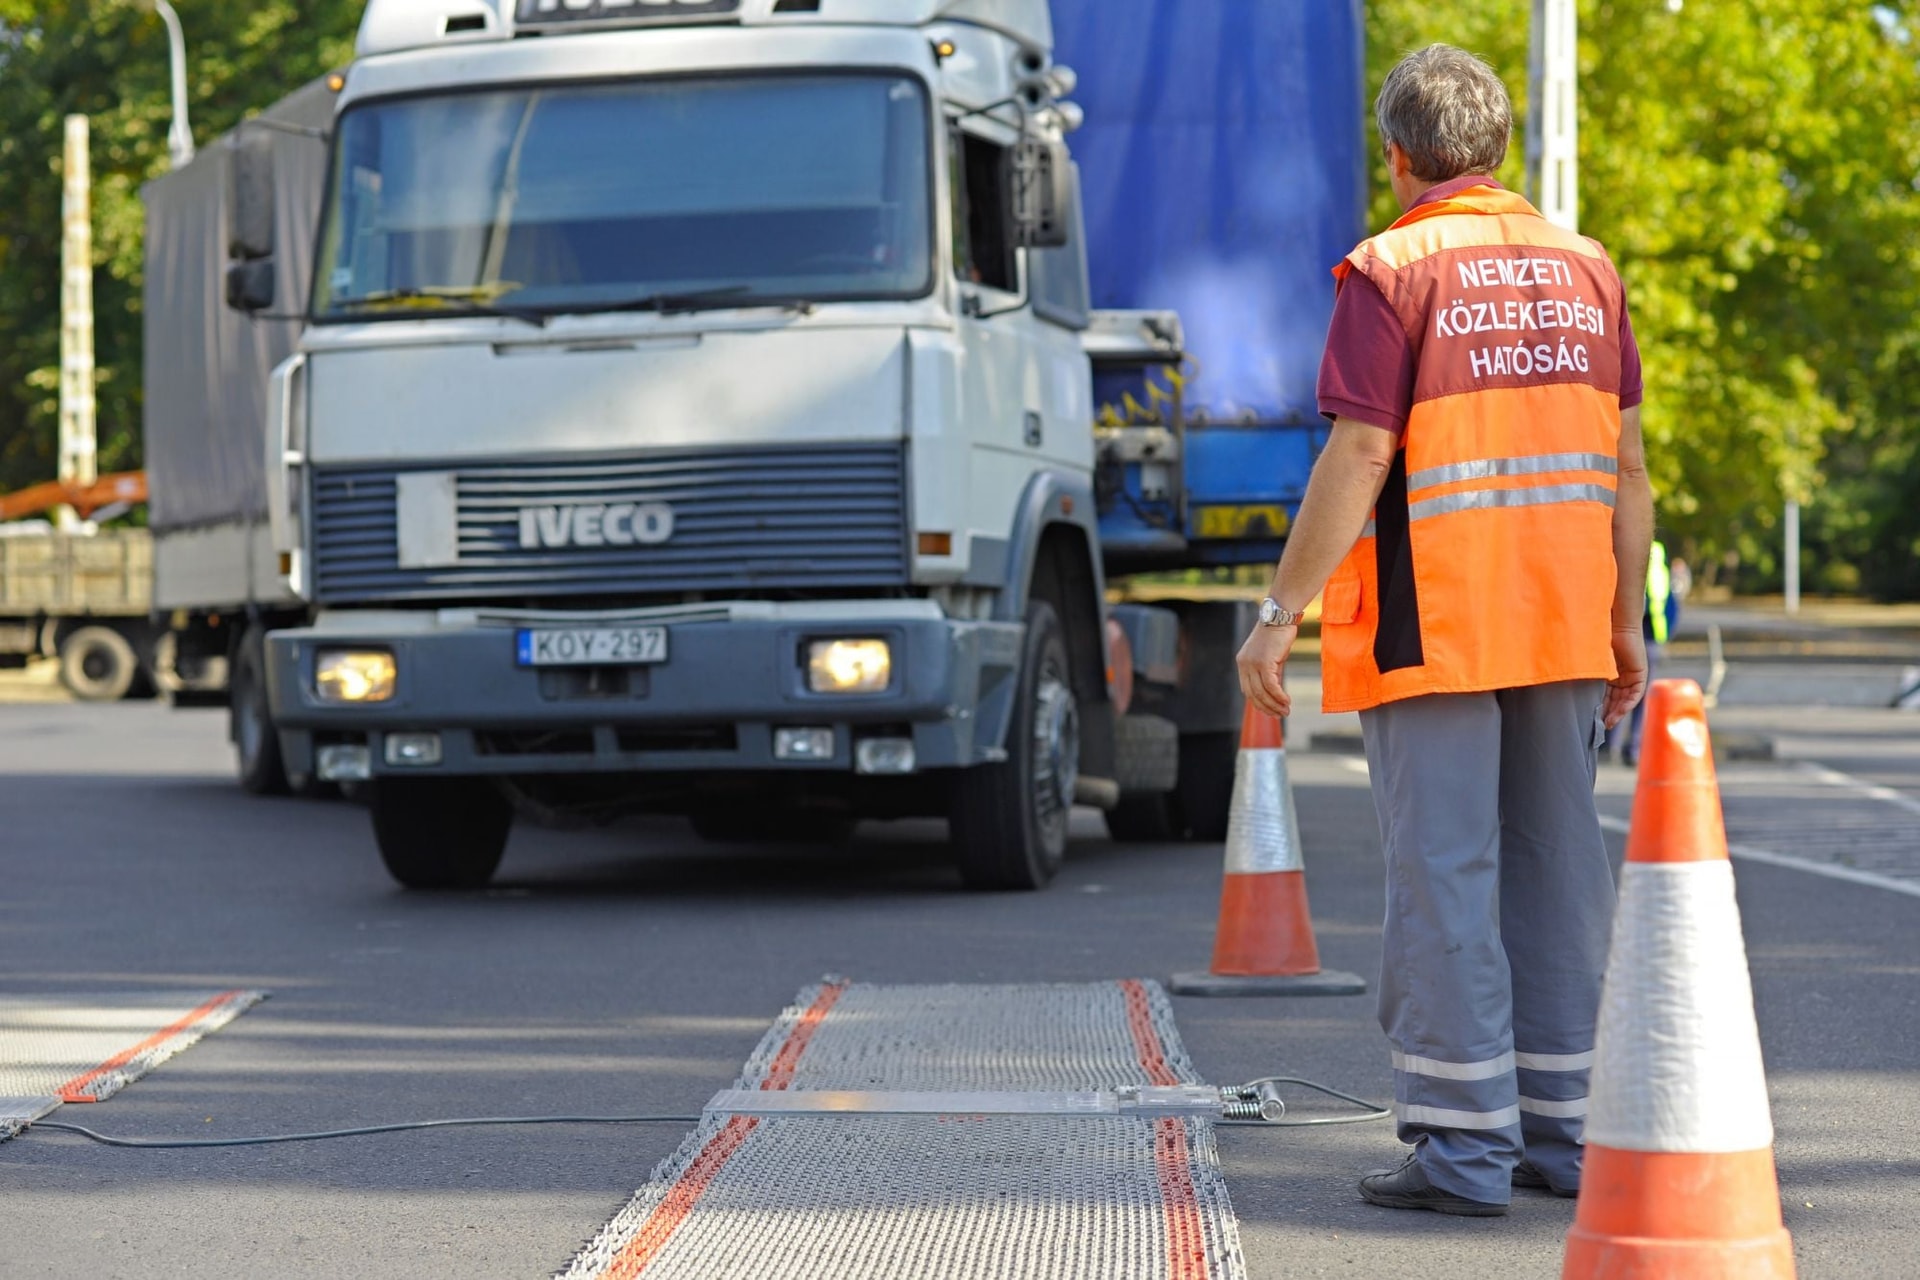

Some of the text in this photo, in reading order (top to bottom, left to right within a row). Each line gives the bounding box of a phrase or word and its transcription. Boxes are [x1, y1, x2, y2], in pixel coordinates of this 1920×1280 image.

[1457, 258, 1573, 288] NEMZETI
[1436, 296, 1605, 338] KÖZLEKEDÉSI
[1469, 336, 1589, 378] HATÓSÁG
[519, 503, 674, 548] IVECO
[537, 631, 660, 660] KOY-297
